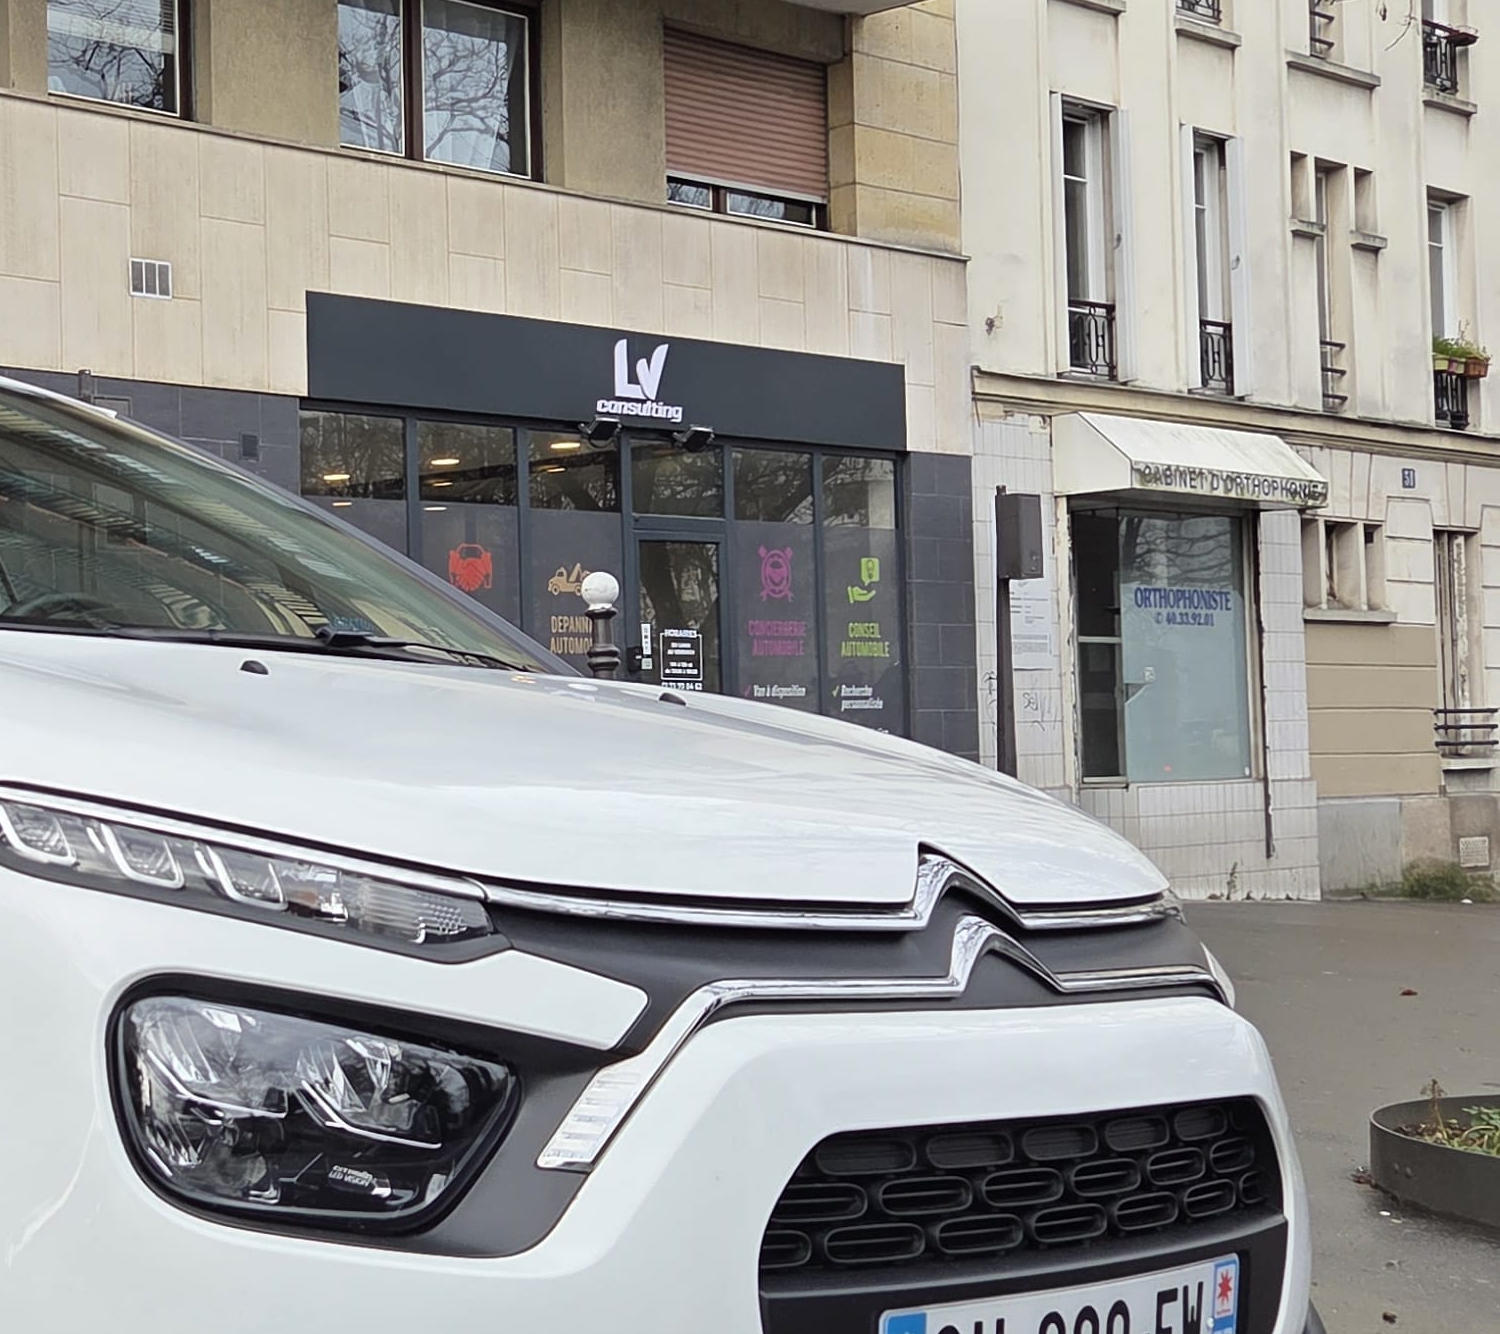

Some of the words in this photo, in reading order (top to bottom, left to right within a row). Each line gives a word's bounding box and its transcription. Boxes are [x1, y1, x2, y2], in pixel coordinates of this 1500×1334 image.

[613, 337, 670, 401] LV
[596, 398, 684, 423] consulting
[1141, 464, 1205, 489] CABINET
[1404, 470, 1413, 487] 51
[1134, 586, 1232, 611] ORTHOPHONISTE
[550, 615, 592, 634] DEPANN
[848, 622, 881, 638] CONSEIL
[550, 637, 592, 654] AUTOMO
[841, 641, 890, 658] AUTOMOBILE
[328, 1170, 344, 1180] LED
